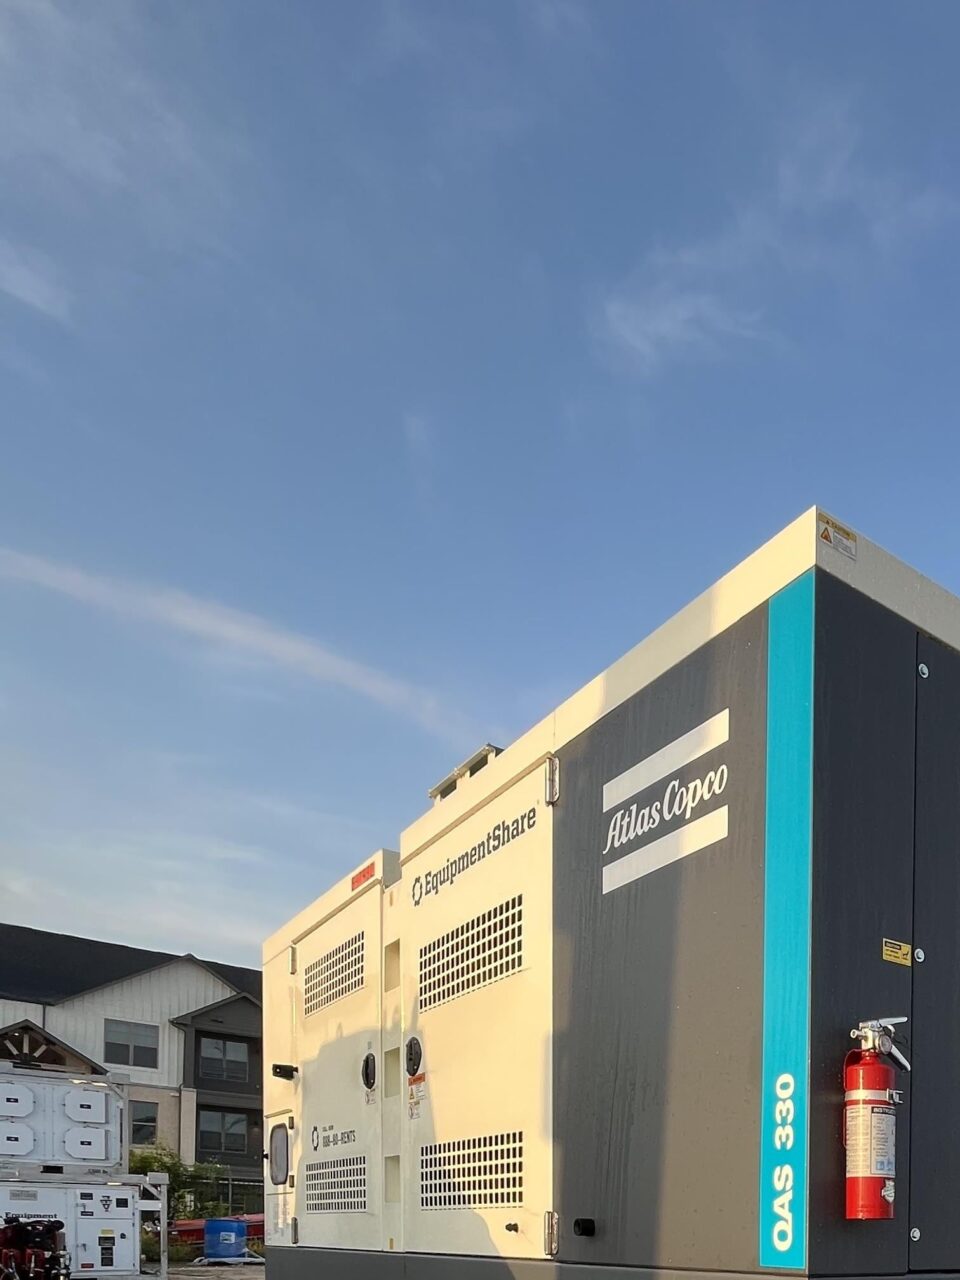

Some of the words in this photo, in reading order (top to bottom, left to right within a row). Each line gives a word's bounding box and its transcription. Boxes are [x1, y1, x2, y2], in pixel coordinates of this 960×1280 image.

[424, 807, 537, 896] EquipmentShare
[602, 801, 661, 855] Atlas
[662, 764, 728, 821] Copco
[774, 1073, 795, 1150] 330
[772, 1164, 794, 1251] QAS
